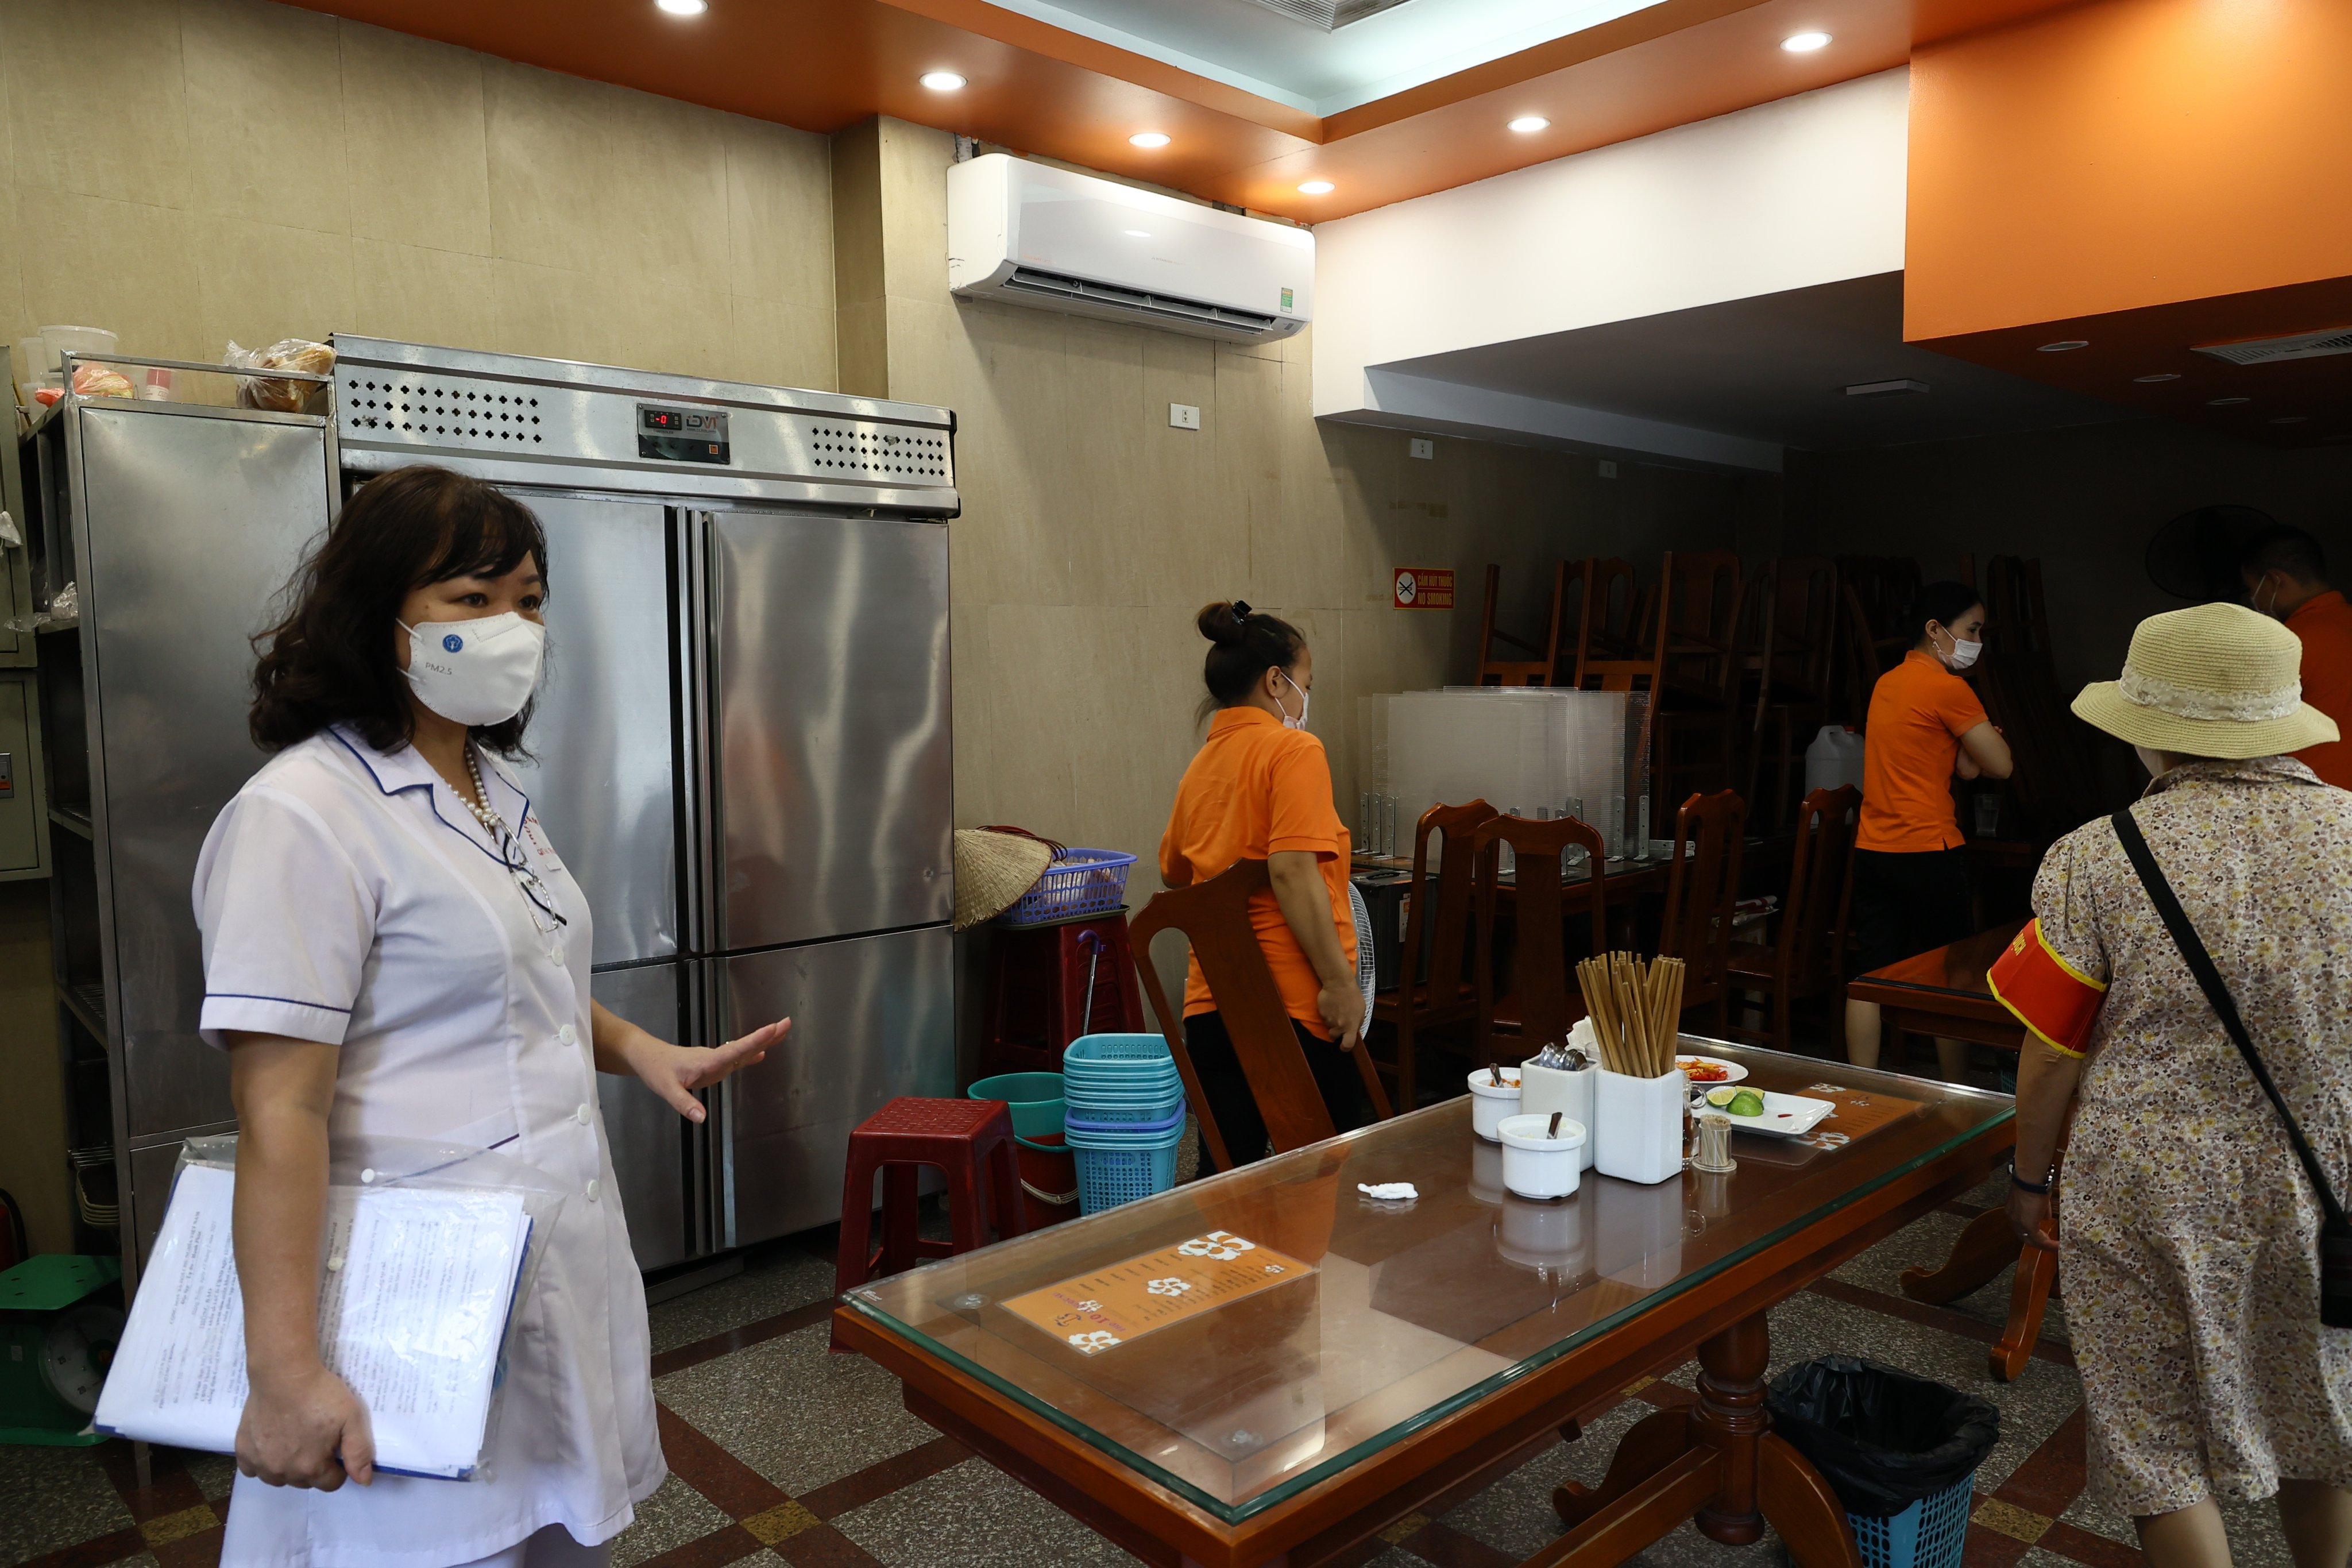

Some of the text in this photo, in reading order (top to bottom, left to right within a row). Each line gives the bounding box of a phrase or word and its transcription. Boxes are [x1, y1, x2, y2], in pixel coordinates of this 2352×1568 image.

[1418, 571, 1453, 588] CẤM HÚT THUỐC
[1418, 592, 1452, 605] NO SMOKING
[425, 662, 453, 675] PM2.5
